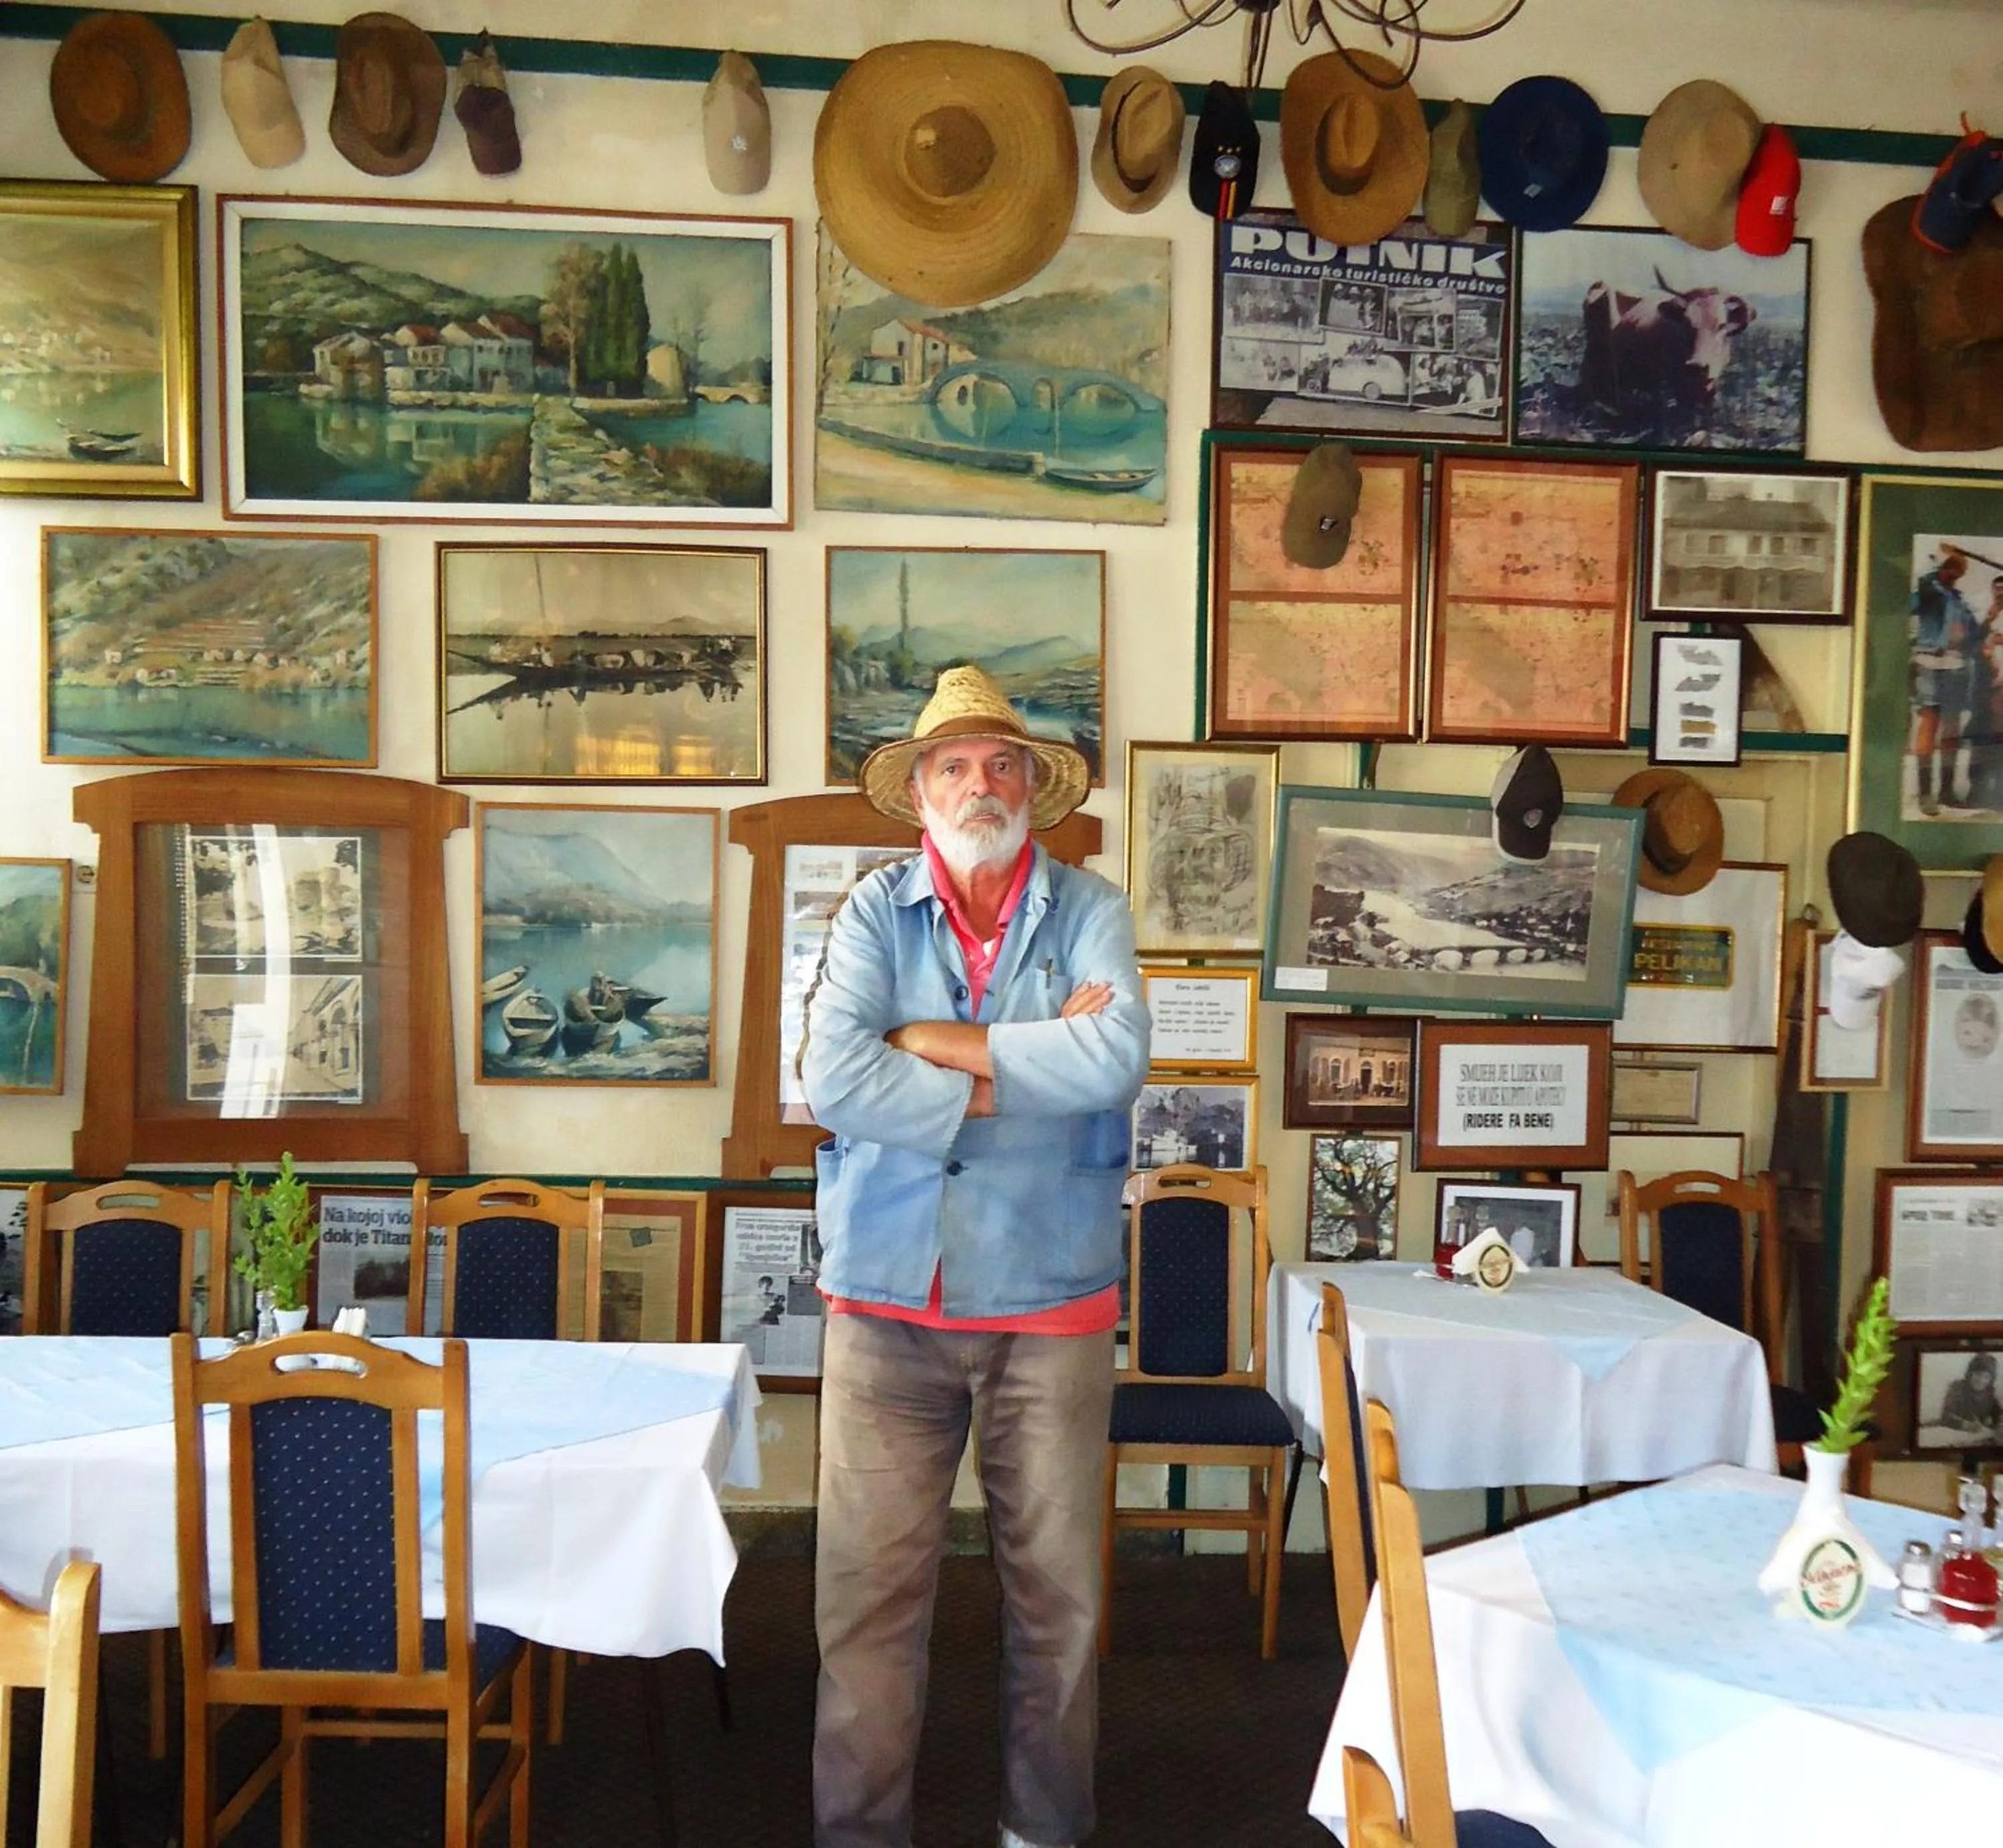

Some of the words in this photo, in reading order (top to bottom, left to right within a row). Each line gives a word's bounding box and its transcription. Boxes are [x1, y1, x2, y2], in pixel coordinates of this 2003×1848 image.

[1231, 225, 1507, 279] PUTNIK
[1231, 256, 1342, 279] Akcionarsko
[1437, 276, 1506, 294] društvo
[1509, 1113, 1520, 1130] FA
[324, 1207, 344, 1222] Na
[322, 1228, 353, 1243] dok
[354, 1228, 369, 1246] je
